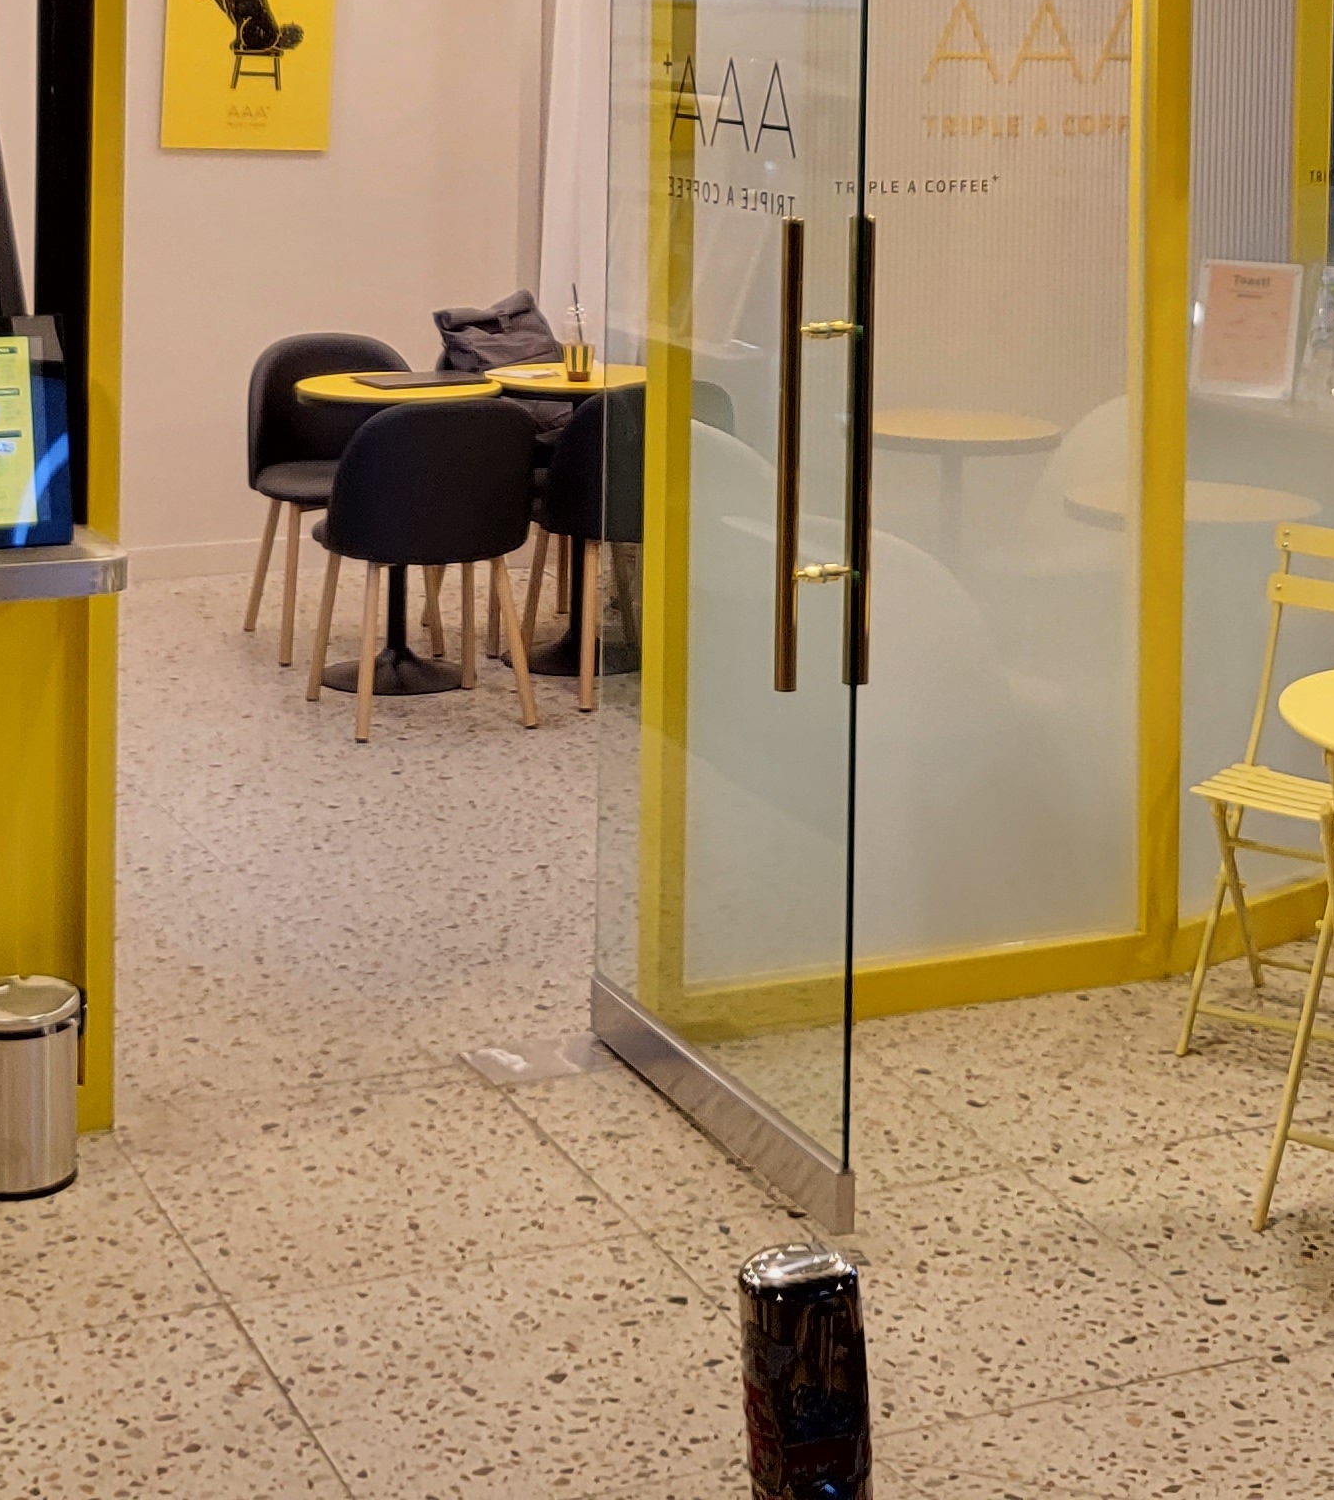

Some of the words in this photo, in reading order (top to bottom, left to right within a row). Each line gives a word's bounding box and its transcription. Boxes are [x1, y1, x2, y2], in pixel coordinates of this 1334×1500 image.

[1062, 114, 1130, 137] COFF
[835, 180, 899, 194] TRPLE
[907, 180, 916, 193] A
